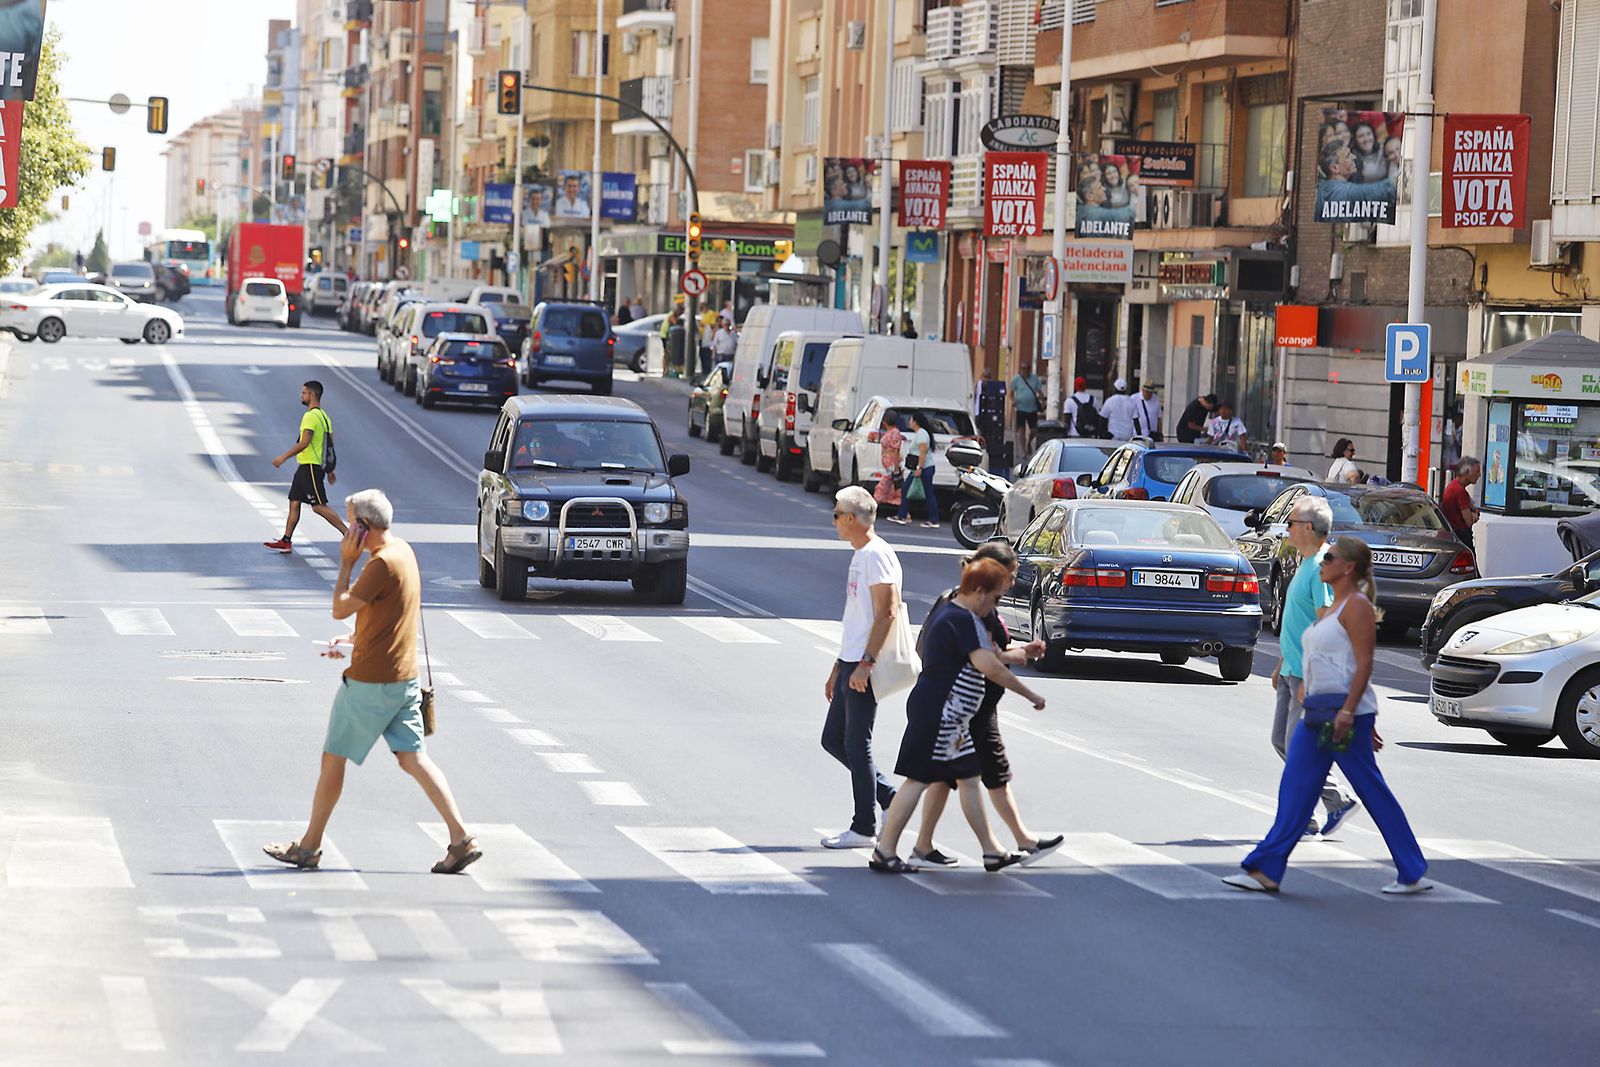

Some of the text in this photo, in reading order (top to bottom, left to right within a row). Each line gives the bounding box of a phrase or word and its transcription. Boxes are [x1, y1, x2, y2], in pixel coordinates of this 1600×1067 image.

[987, 115, 1060, 133] LABORATORI
[1454, 125, 1514, 151] ESPAÑA
[992, 161, 1037, 180] ESPAÑA
[1453, 152, 1513, 173] AVANZA
[905, 167, 942, 183] ESPAÑA
[904, 182, 941, 196] AVANZA
[991, 180, 1036, 197] AVANZA
[1453, 179, 1513, 211] VOTA
[828, 210, 869, 222] ADELANTE
[904, 198, 940, 219] VOTA
[991, 200, 1036, 225] VOTA
[1322, 200, 1389, 218] ADELANTE
[1454, 211, 1487, 226] PSOE
[992, 224, 1018, 235] PSOE
[1080, 220, 1130, 236] ADELANTE
[1062, 260, 1128, 272] Valenciana
[1278, 336, 1314, 346] orange
[1394, 331, 1420, 375] P
[1530, 374, 1544, 385] MI
[1582, 374, 1596, 383] EL
[576, 539, 624, 549] 2547 CWR
[1400, 554, 1420, 565] LSX
[1138, 571, 1198, 587] H 9844 V
